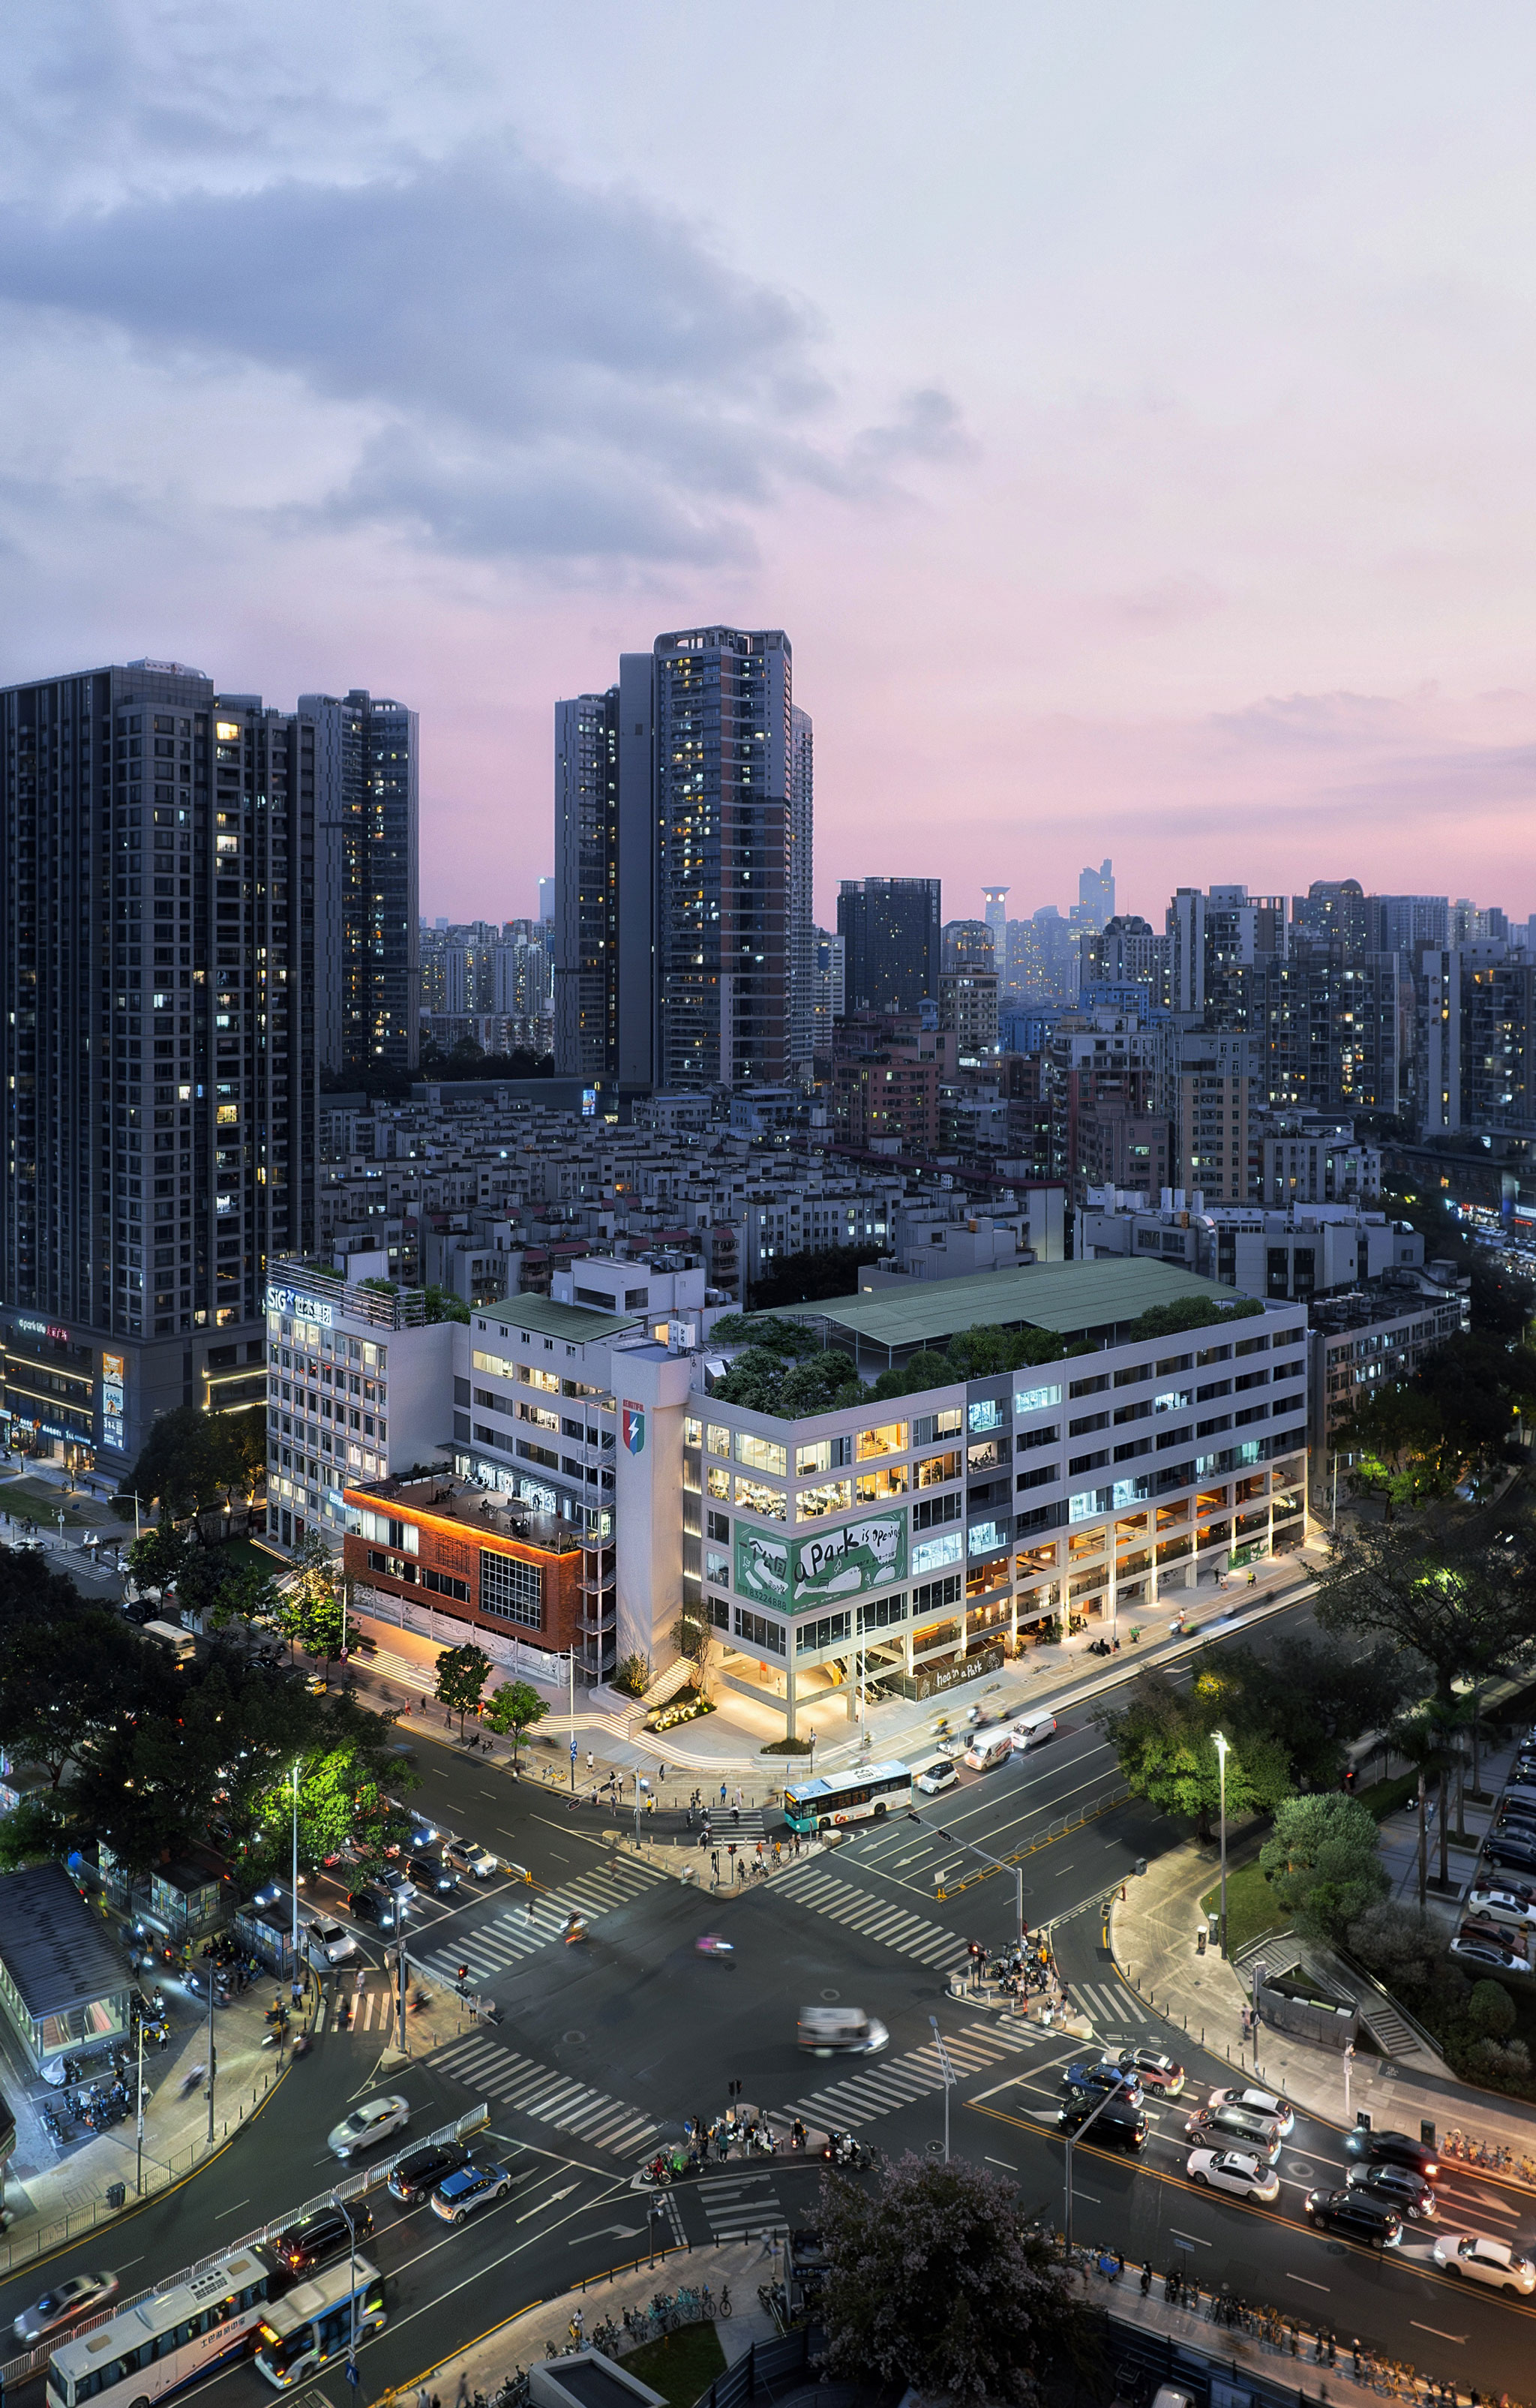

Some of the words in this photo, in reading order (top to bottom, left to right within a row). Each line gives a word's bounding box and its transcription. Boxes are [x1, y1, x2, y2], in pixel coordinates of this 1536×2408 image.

[739, 1541, 787, 1579] 一个公园
[794, 1562, 810, 1583] a
[862, 1529, 869, 1542] is
[750, 1588, 787, 1611] 83224888
